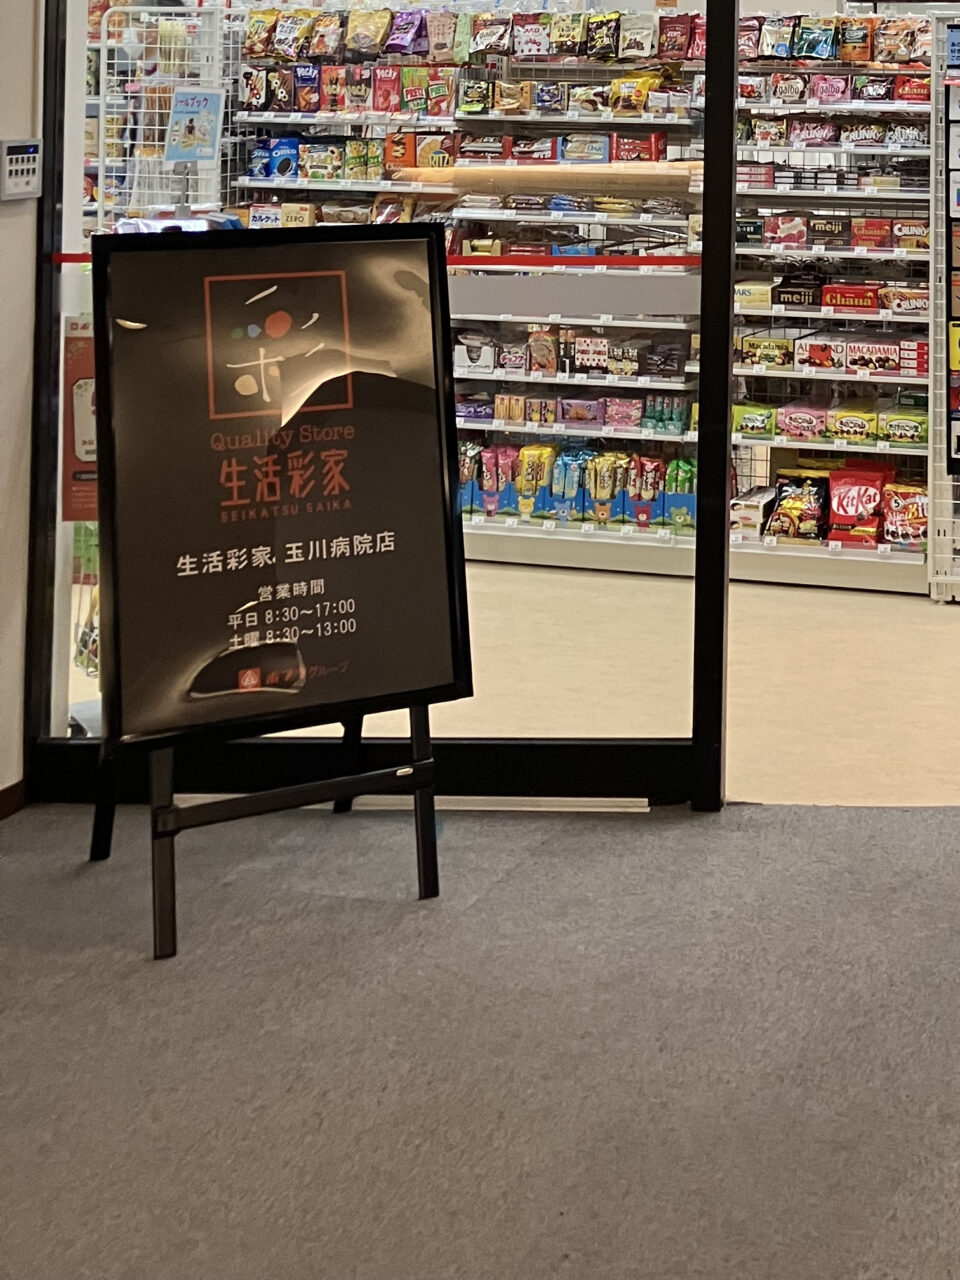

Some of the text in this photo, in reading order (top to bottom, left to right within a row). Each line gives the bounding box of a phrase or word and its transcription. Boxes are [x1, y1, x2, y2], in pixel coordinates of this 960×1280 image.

[376, 68, 397, 79] Pocky
[819, 84, 840, 95] galbo
[841, 129, 883, 143] CRUNKY
[272, 148, 297, 158] OREO
[430, 153, 450, 168] RITZ
[251, 214, 280, 224] カルケット
[815, 221, 842, 234] meiji
[893, 224, 929, 237] CRUNKY
[780, 291, 813, 305] meiji
[825, 292, 872, 307] Ghana
[747, 341, 789, 351] Macadamia
[848, 345, 898, 356] MACADAMIA
[210, 424, 355, 451] Quality Store
[219, 449, 350, 506] 生活彩家
[832, 485, 879, 515] KitKat
[220, 500, 353, 523] SEIKATSU SAIKA
[176, 531, 395, 576] 生活彩家 玉川病院店
[257, 578, 325, 602] 営業時間
[227, 613, 258, 630] 平日
[229, 631, 261, 651] 土曜
